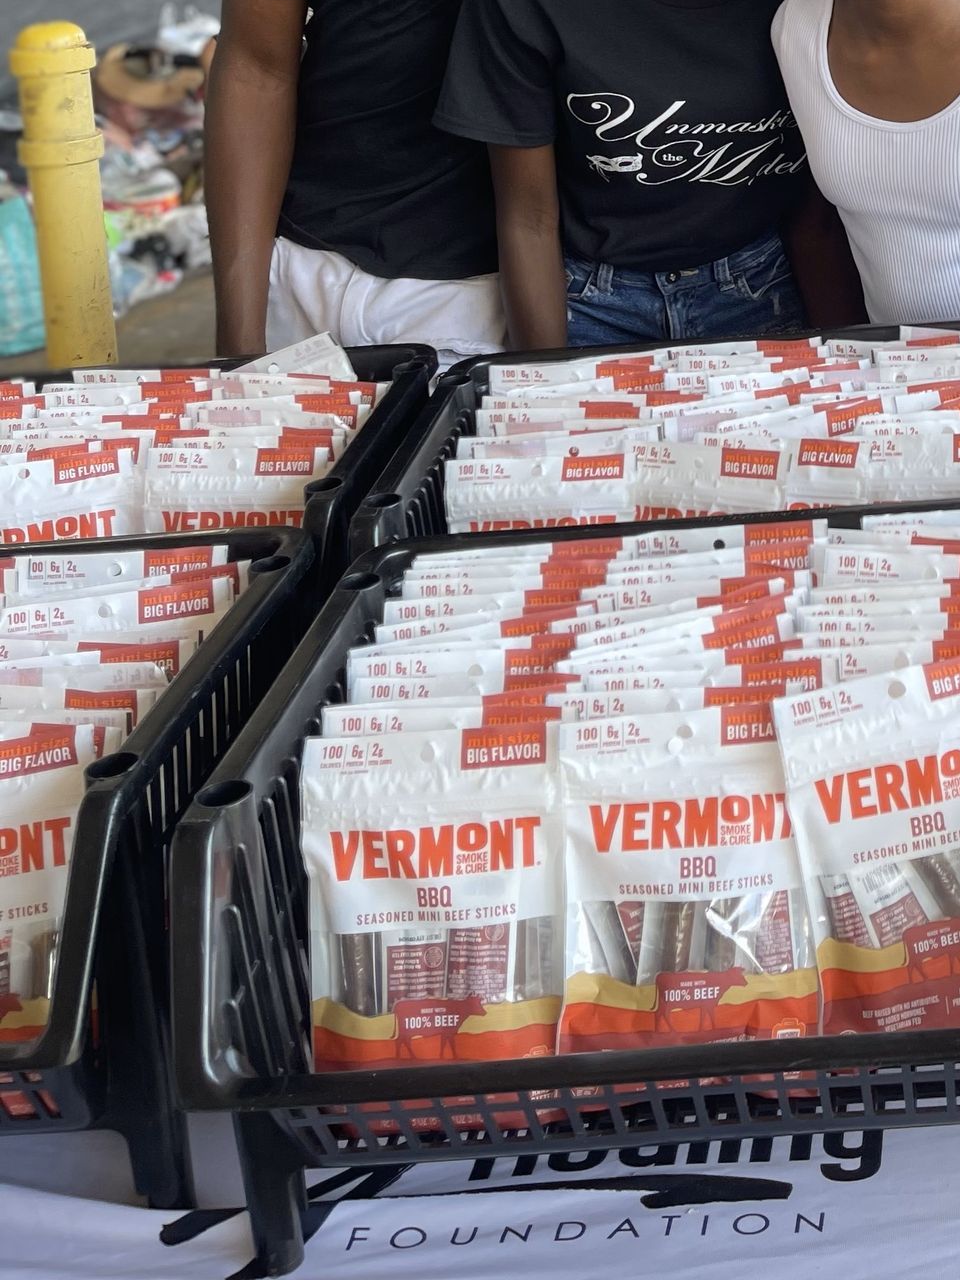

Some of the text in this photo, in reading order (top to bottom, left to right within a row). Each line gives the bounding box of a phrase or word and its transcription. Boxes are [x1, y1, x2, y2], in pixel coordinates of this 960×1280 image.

[636, 140, 806, 186] the Mdel
[260, 461, 310, 472] BIG FLAVOR
[802, 452, 852, 464] BIG FLAVOR
[59, 462, 115, 480] BIG FLAVOR
[566, 466, 620, 478] BIG FLAVOR
[725, 462, 774, 475] BIG FLAVOR
[0, 510, 116, 543] RMONT
[144, 588, 209, 604] mini size
[144, 598, 209, 618] BIG FLAVOR
[932, 678, 953, 695] BIG
[790, 691, 851, 717] 100 6g 2g
[468, 731, 539, 748] mini size
[575, 723, 640, 743] 100 6g 2g
[27, 747, 71, 767] FLAVOR
[323, 743, 383, 759] 100 6g 2g
[466, 743, 541, 764] BIG FLAVOR
[944, 791, 951, 801] &
[720, 825, 751, 836] SMOKE
[910, 811, 946, 838] BBQ
[329, 815, 541, 882] VERMONT
[720, 834, 751, 846] & CURE
[456, 852, 488, 864] SMOKE
[853, 843, 908, 865] SEASONED
[912, 839, 936, 853] MINI
[455, 862, 488, 875] & CURE
[680, 856, 717, 879] BBQ
[619, 874, 773, 895] SEASONED MINI BEEF STICKS
[416, 886, 452, 908] BBQ
[8, 902, 48, 919] STICKS
[357, 903, 517, 926] SEASONED MINI BEEF STICKS
[913, 938, 938, 954] 100%
[664, 986, 720, 1002] 100% BEEF
[405, 1015, 459, 1029] 100% BEEF
[346, 1211, 826, 1251] FOUNDATION
